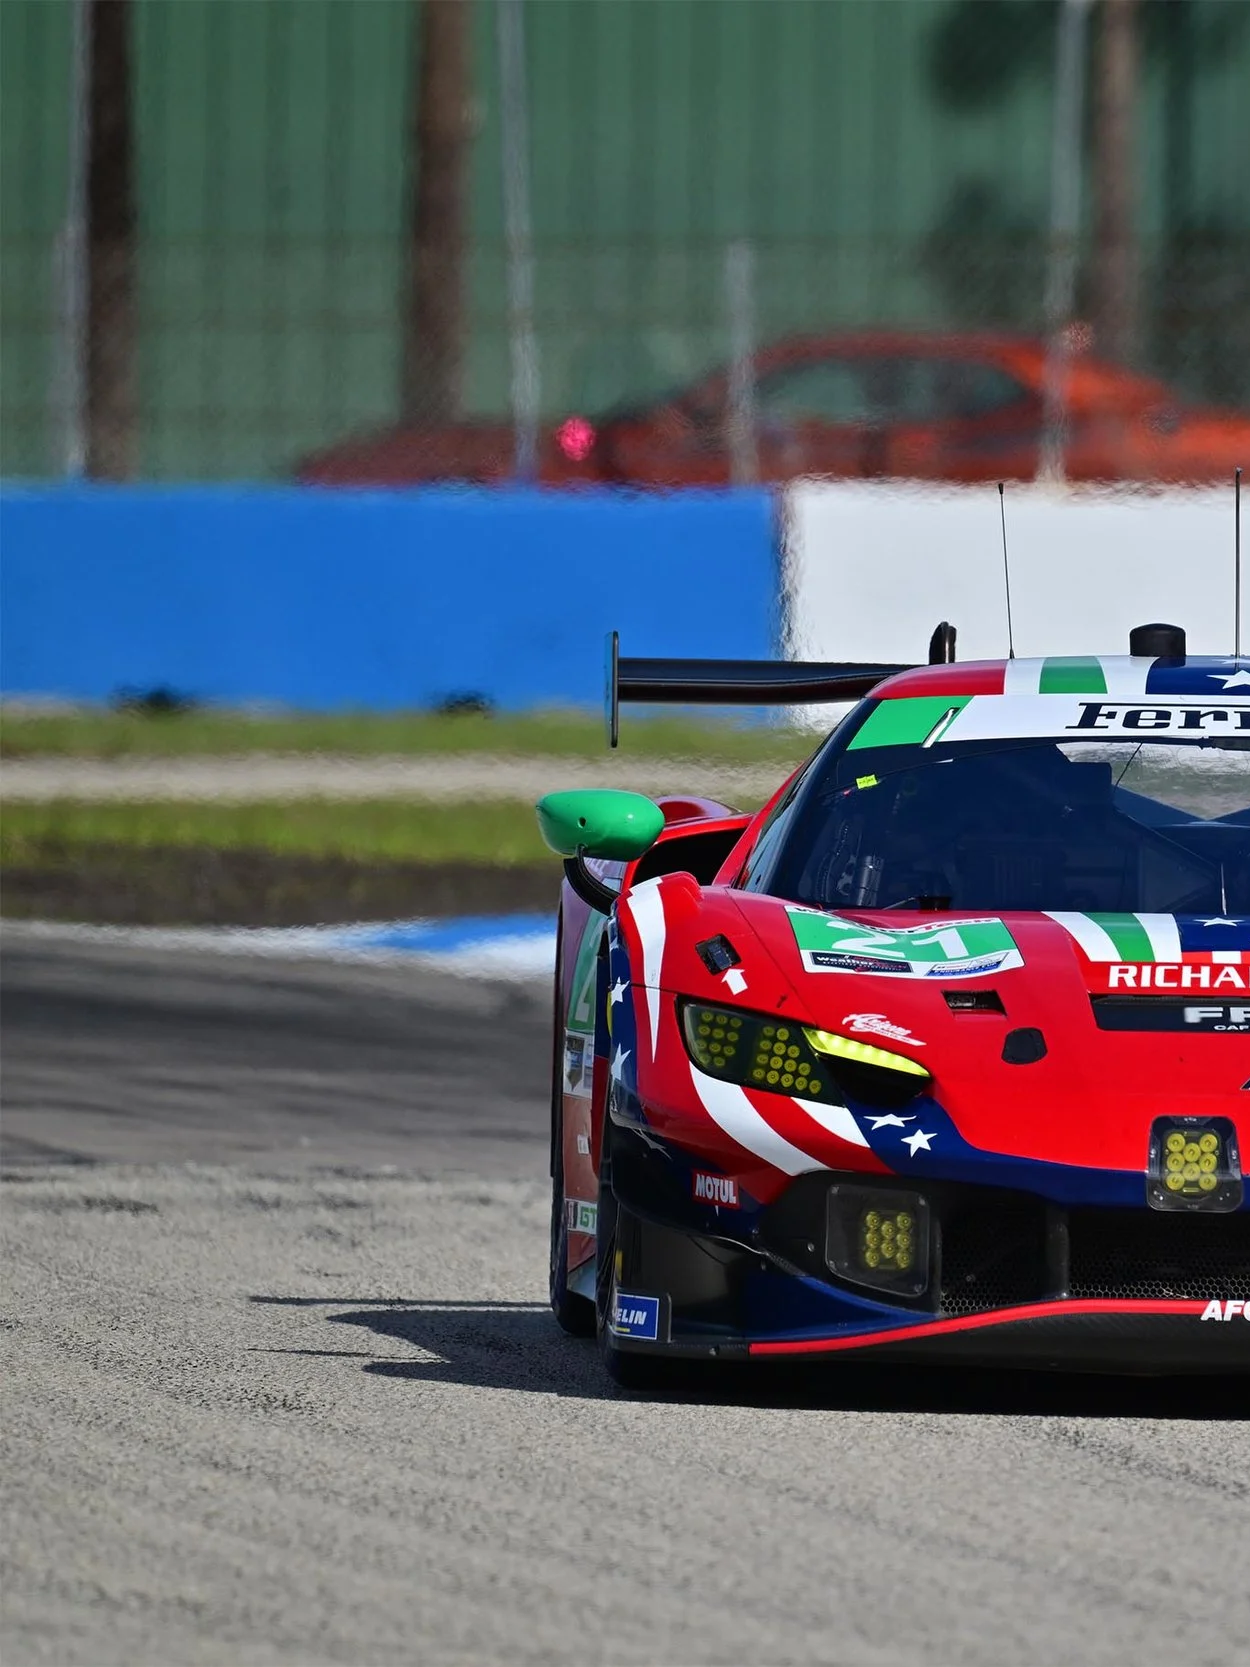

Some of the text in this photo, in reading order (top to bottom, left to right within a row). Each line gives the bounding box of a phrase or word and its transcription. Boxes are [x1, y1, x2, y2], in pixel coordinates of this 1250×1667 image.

[826, 920, 969, 960] 21
[695, 1173, 736, 1204] MOTUL
[616, 1308, 647, 1325] ELIN
